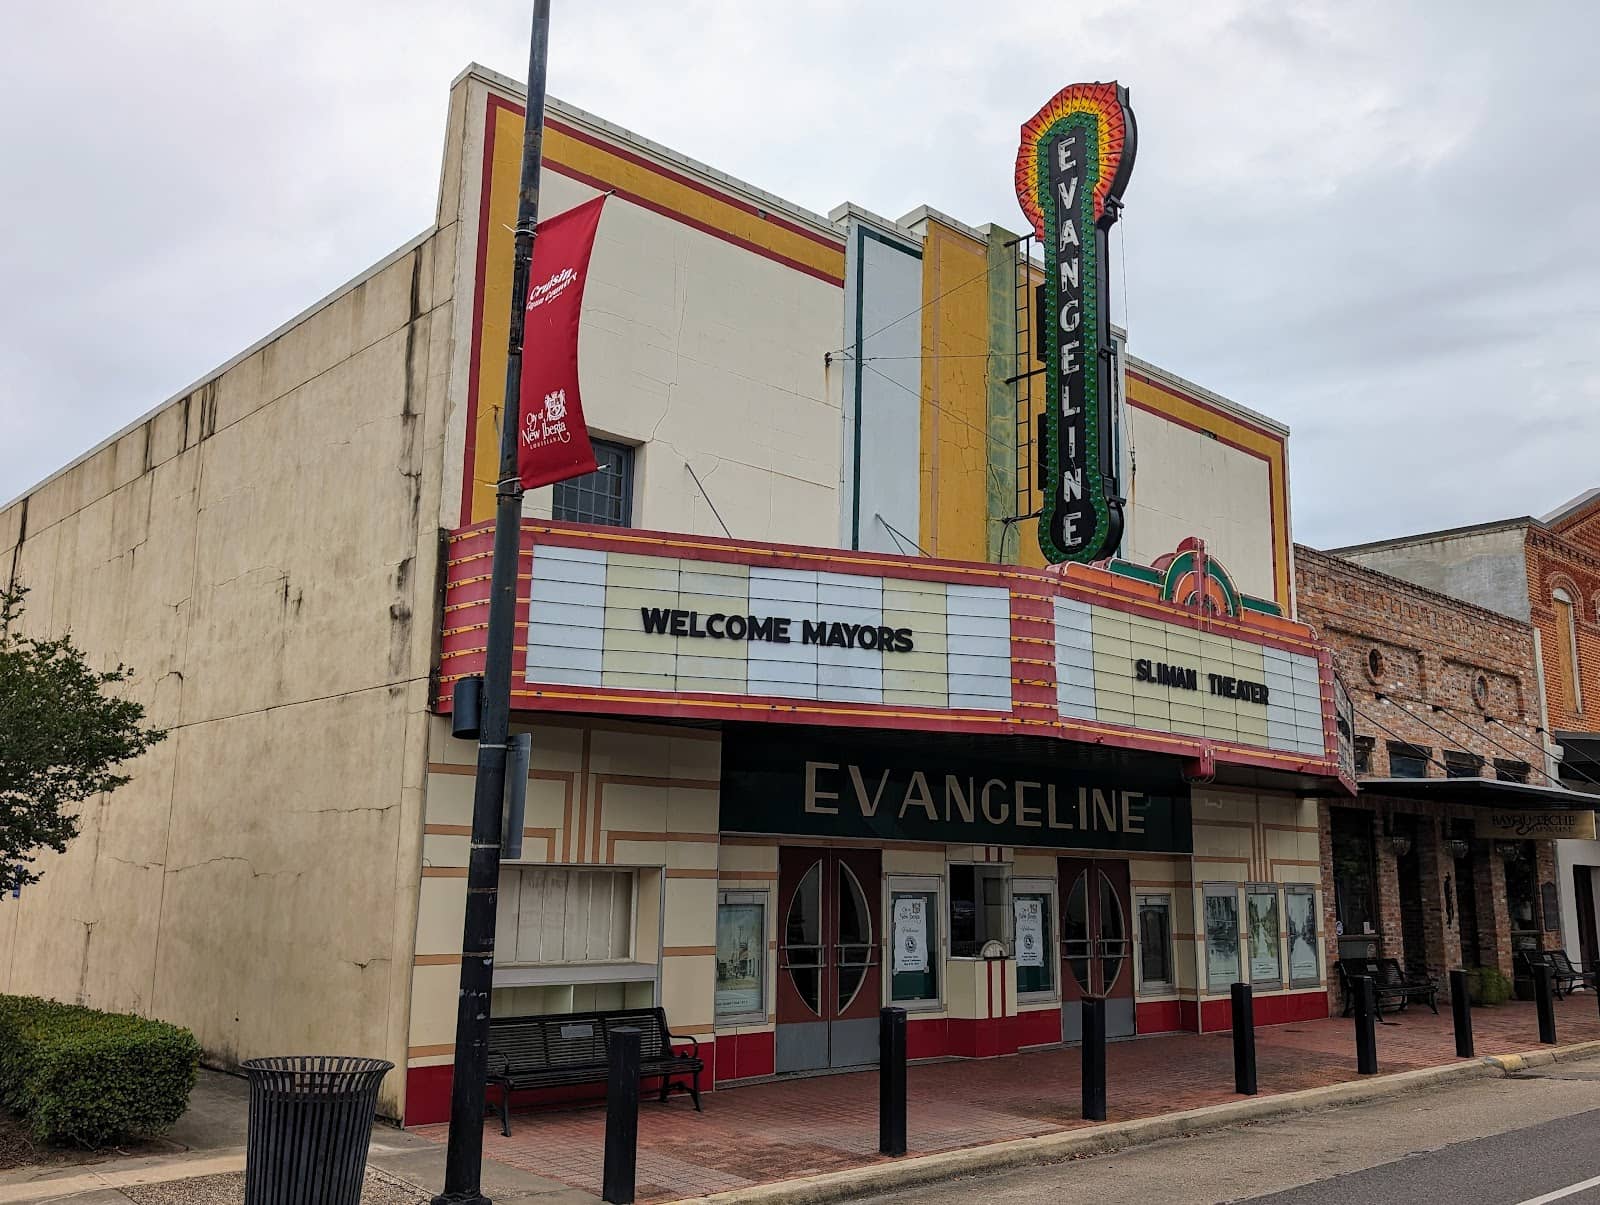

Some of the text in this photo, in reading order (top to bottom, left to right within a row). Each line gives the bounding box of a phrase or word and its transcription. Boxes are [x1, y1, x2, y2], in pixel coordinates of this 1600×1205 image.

[529, 268, 573, 301] Cruisin
[1058, 136, 1083, 546] EVANGELINE
[522, 419, 571, 447] New Iberia
[641, 607, 913, 652] WELCOME MAYORS
[1136, 658, 1270, 705] SLIMAN THEATER
[804, 761, 1145, 833] EVANGELINE
